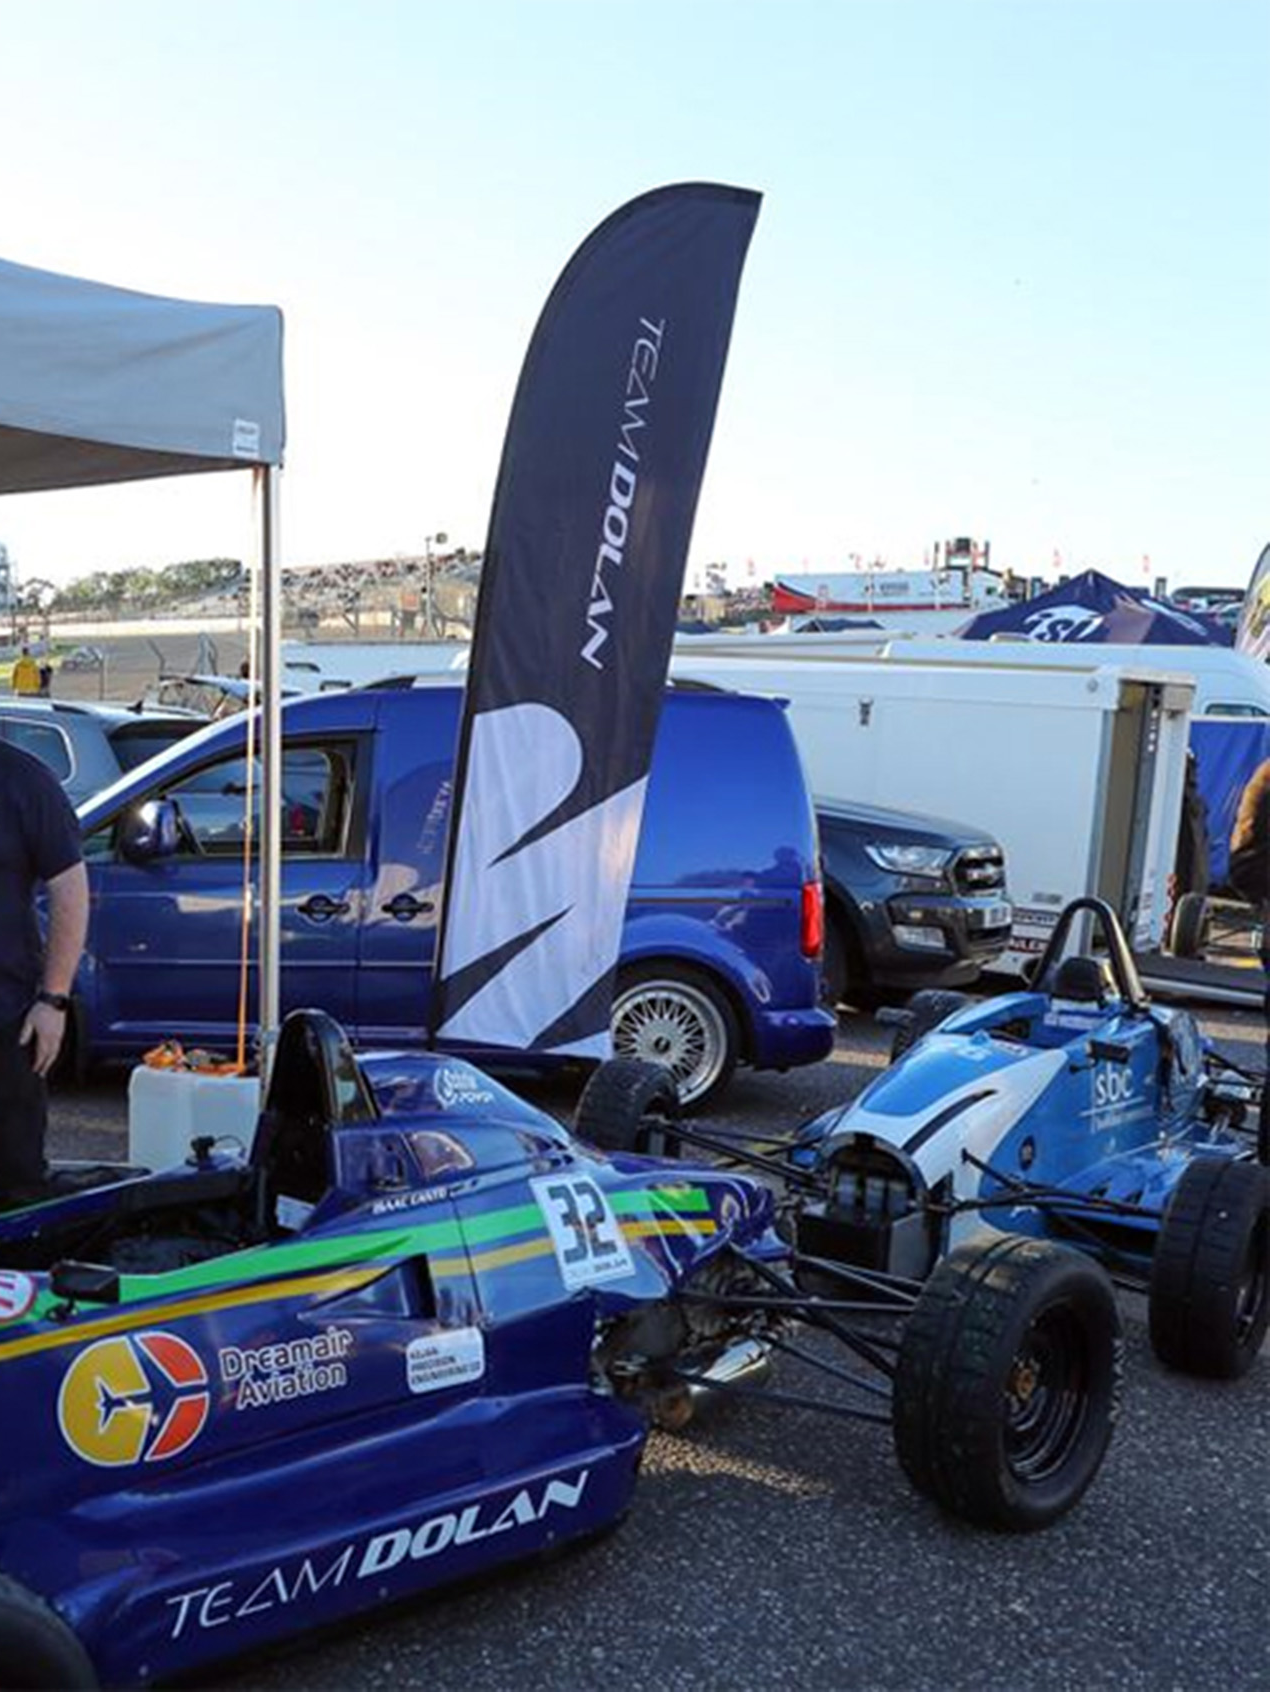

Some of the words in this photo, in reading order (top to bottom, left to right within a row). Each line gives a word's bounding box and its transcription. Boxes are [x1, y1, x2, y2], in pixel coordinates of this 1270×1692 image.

[617, 317, 666, 461] TEAM
[580, 461, 637, 670] DOLAN
[1096, 1061, 1135, 1106] sbc
[546, 1182, 618, 1266] 32
[219, 1325, 354, 1382] Dreamair
[236, 1361, 348, 1411] Aviation
[166, 1544, 356, 1640] TEAM
[356, 1470, 589, 1579] DOLAN
